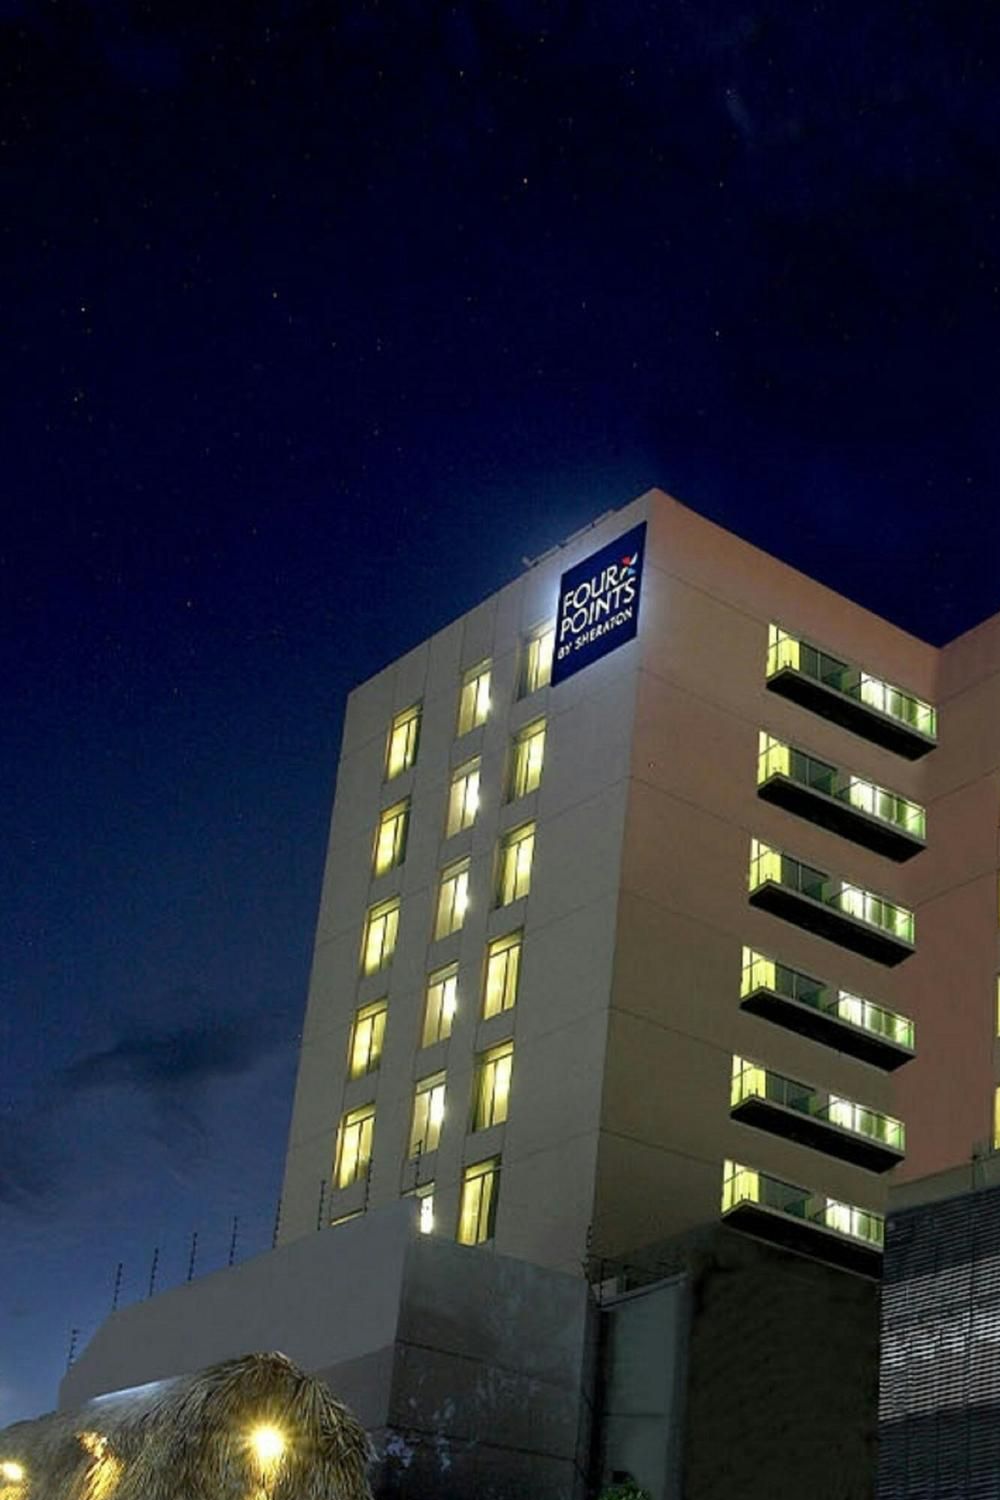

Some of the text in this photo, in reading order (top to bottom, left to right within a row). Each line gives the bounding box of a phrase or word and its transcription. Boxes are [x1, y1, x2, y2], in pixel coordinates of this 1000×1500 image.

[560, 576, 636, 642] POINTS
[562, 564, 618, 617] FOUR
[557, 606, 633, 660] BY SHERATON
